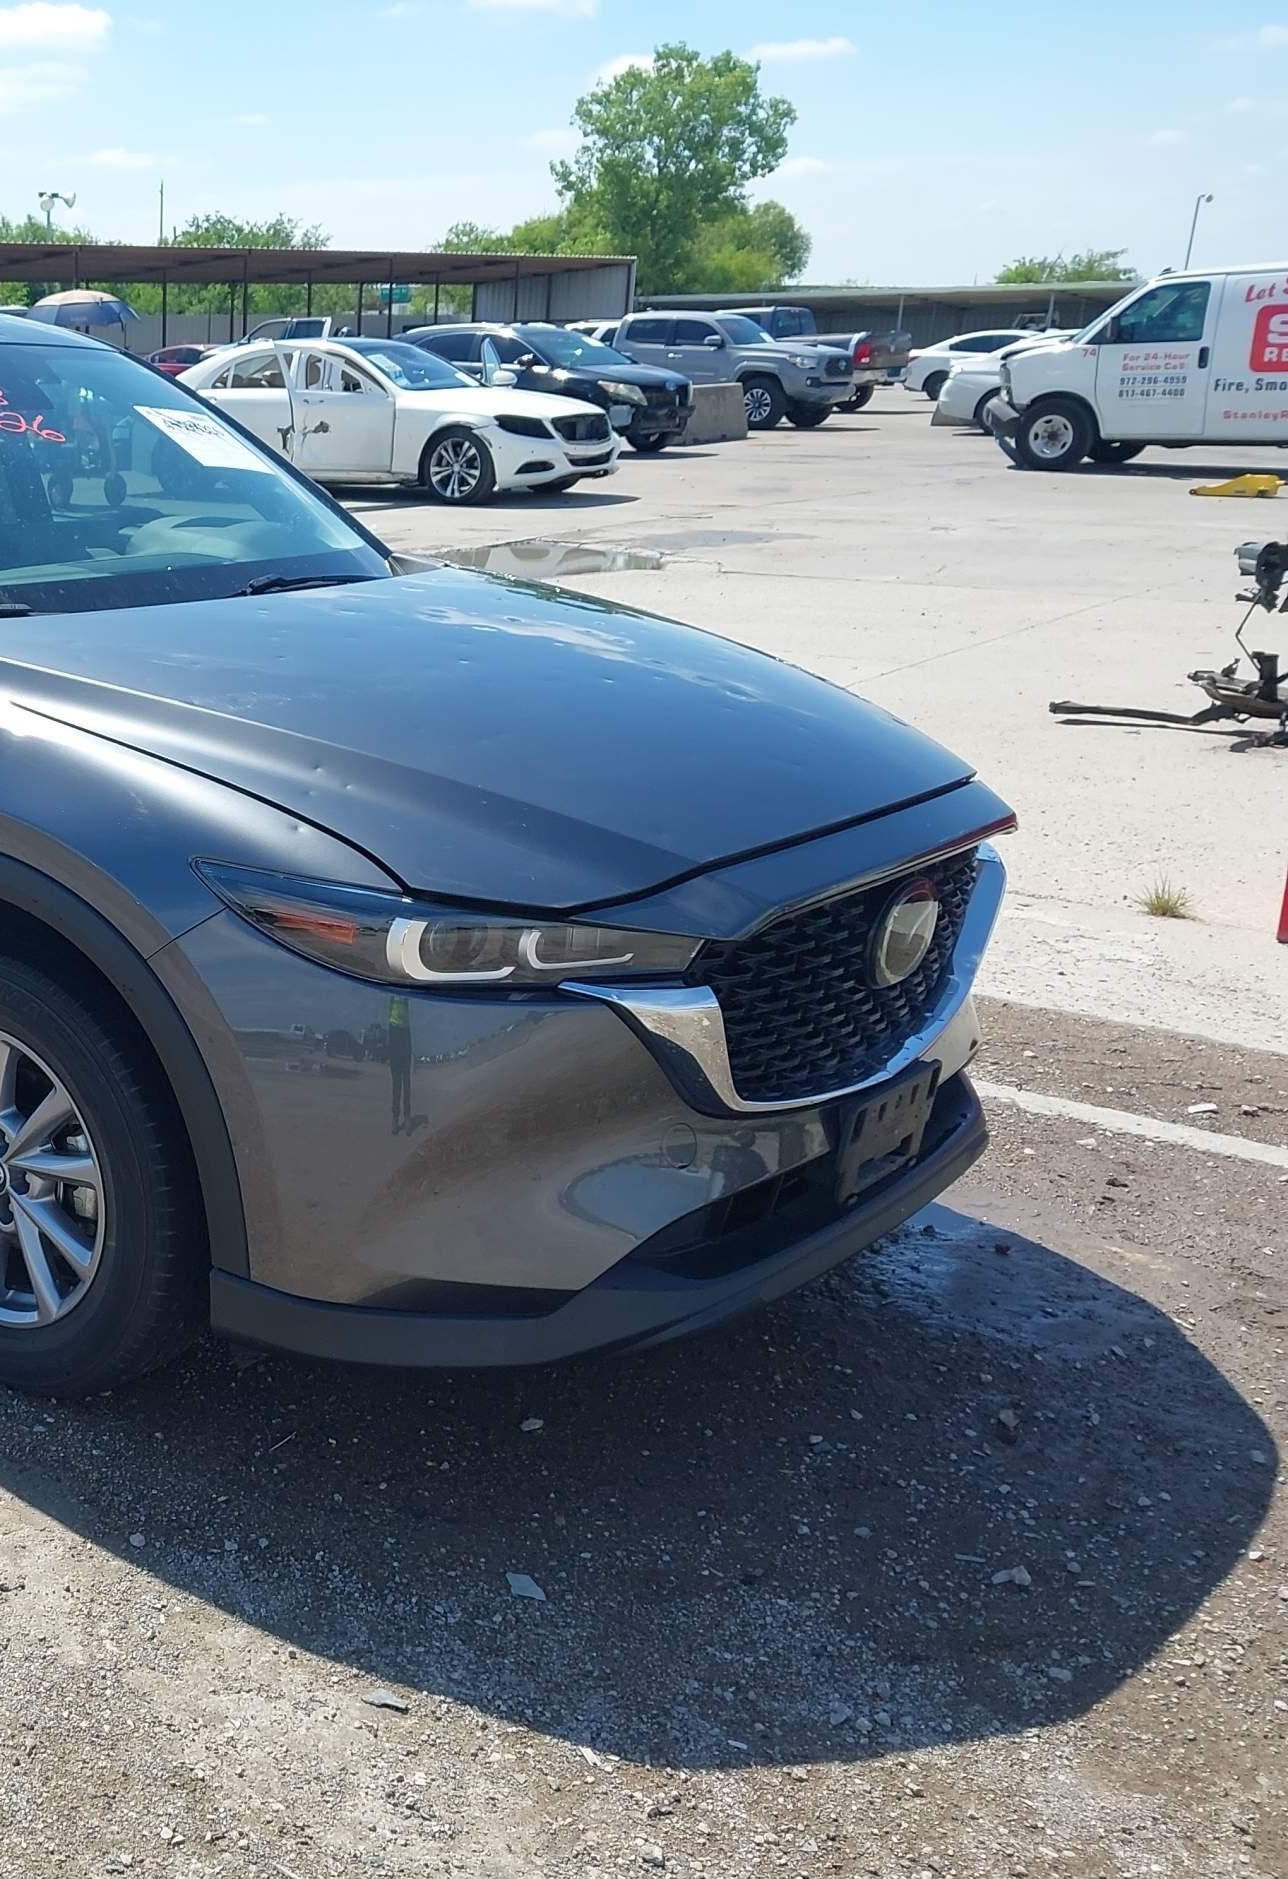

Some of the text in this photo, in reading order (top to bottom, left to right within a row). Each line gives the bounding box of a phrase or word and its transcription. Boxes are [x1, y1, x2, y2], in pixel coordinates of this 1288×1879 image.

[1245, 282, 1276, 303] Let
[1081, 348, 1097, 358] 74
[1123, 352, 1141, 361] For
[1121, 362, 1161, 371] Service
[1214, 378, 1249, 394] Fire,
